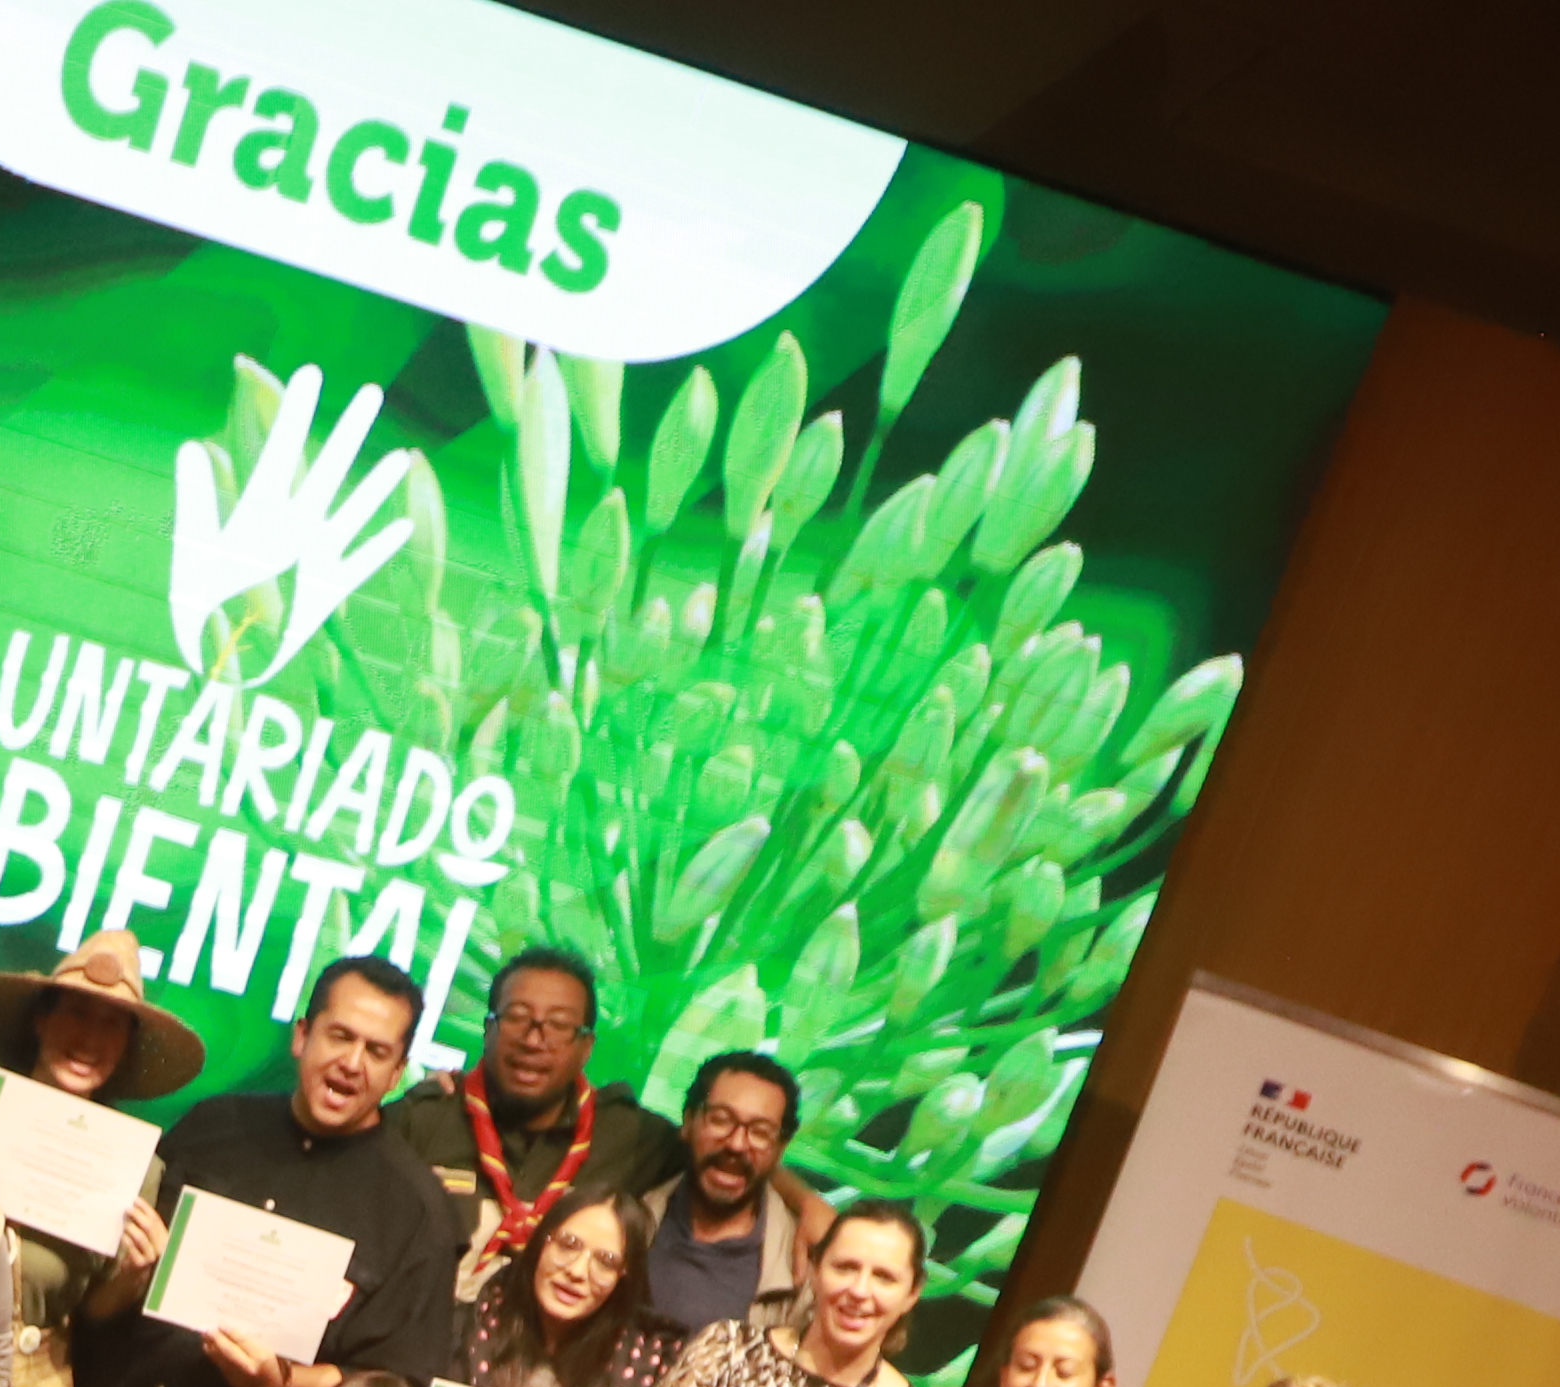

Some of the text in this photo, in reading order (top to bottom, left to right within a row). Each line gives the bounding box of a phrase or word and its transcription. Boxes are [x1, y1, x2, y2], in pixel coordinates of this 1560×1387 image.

[61, 0, 622, 293] Gracias
[1243, 1122, 1345, 1170] FRANÇAISE
[1251, 1103, 1361, 1154] RÉPUBLIQUE
